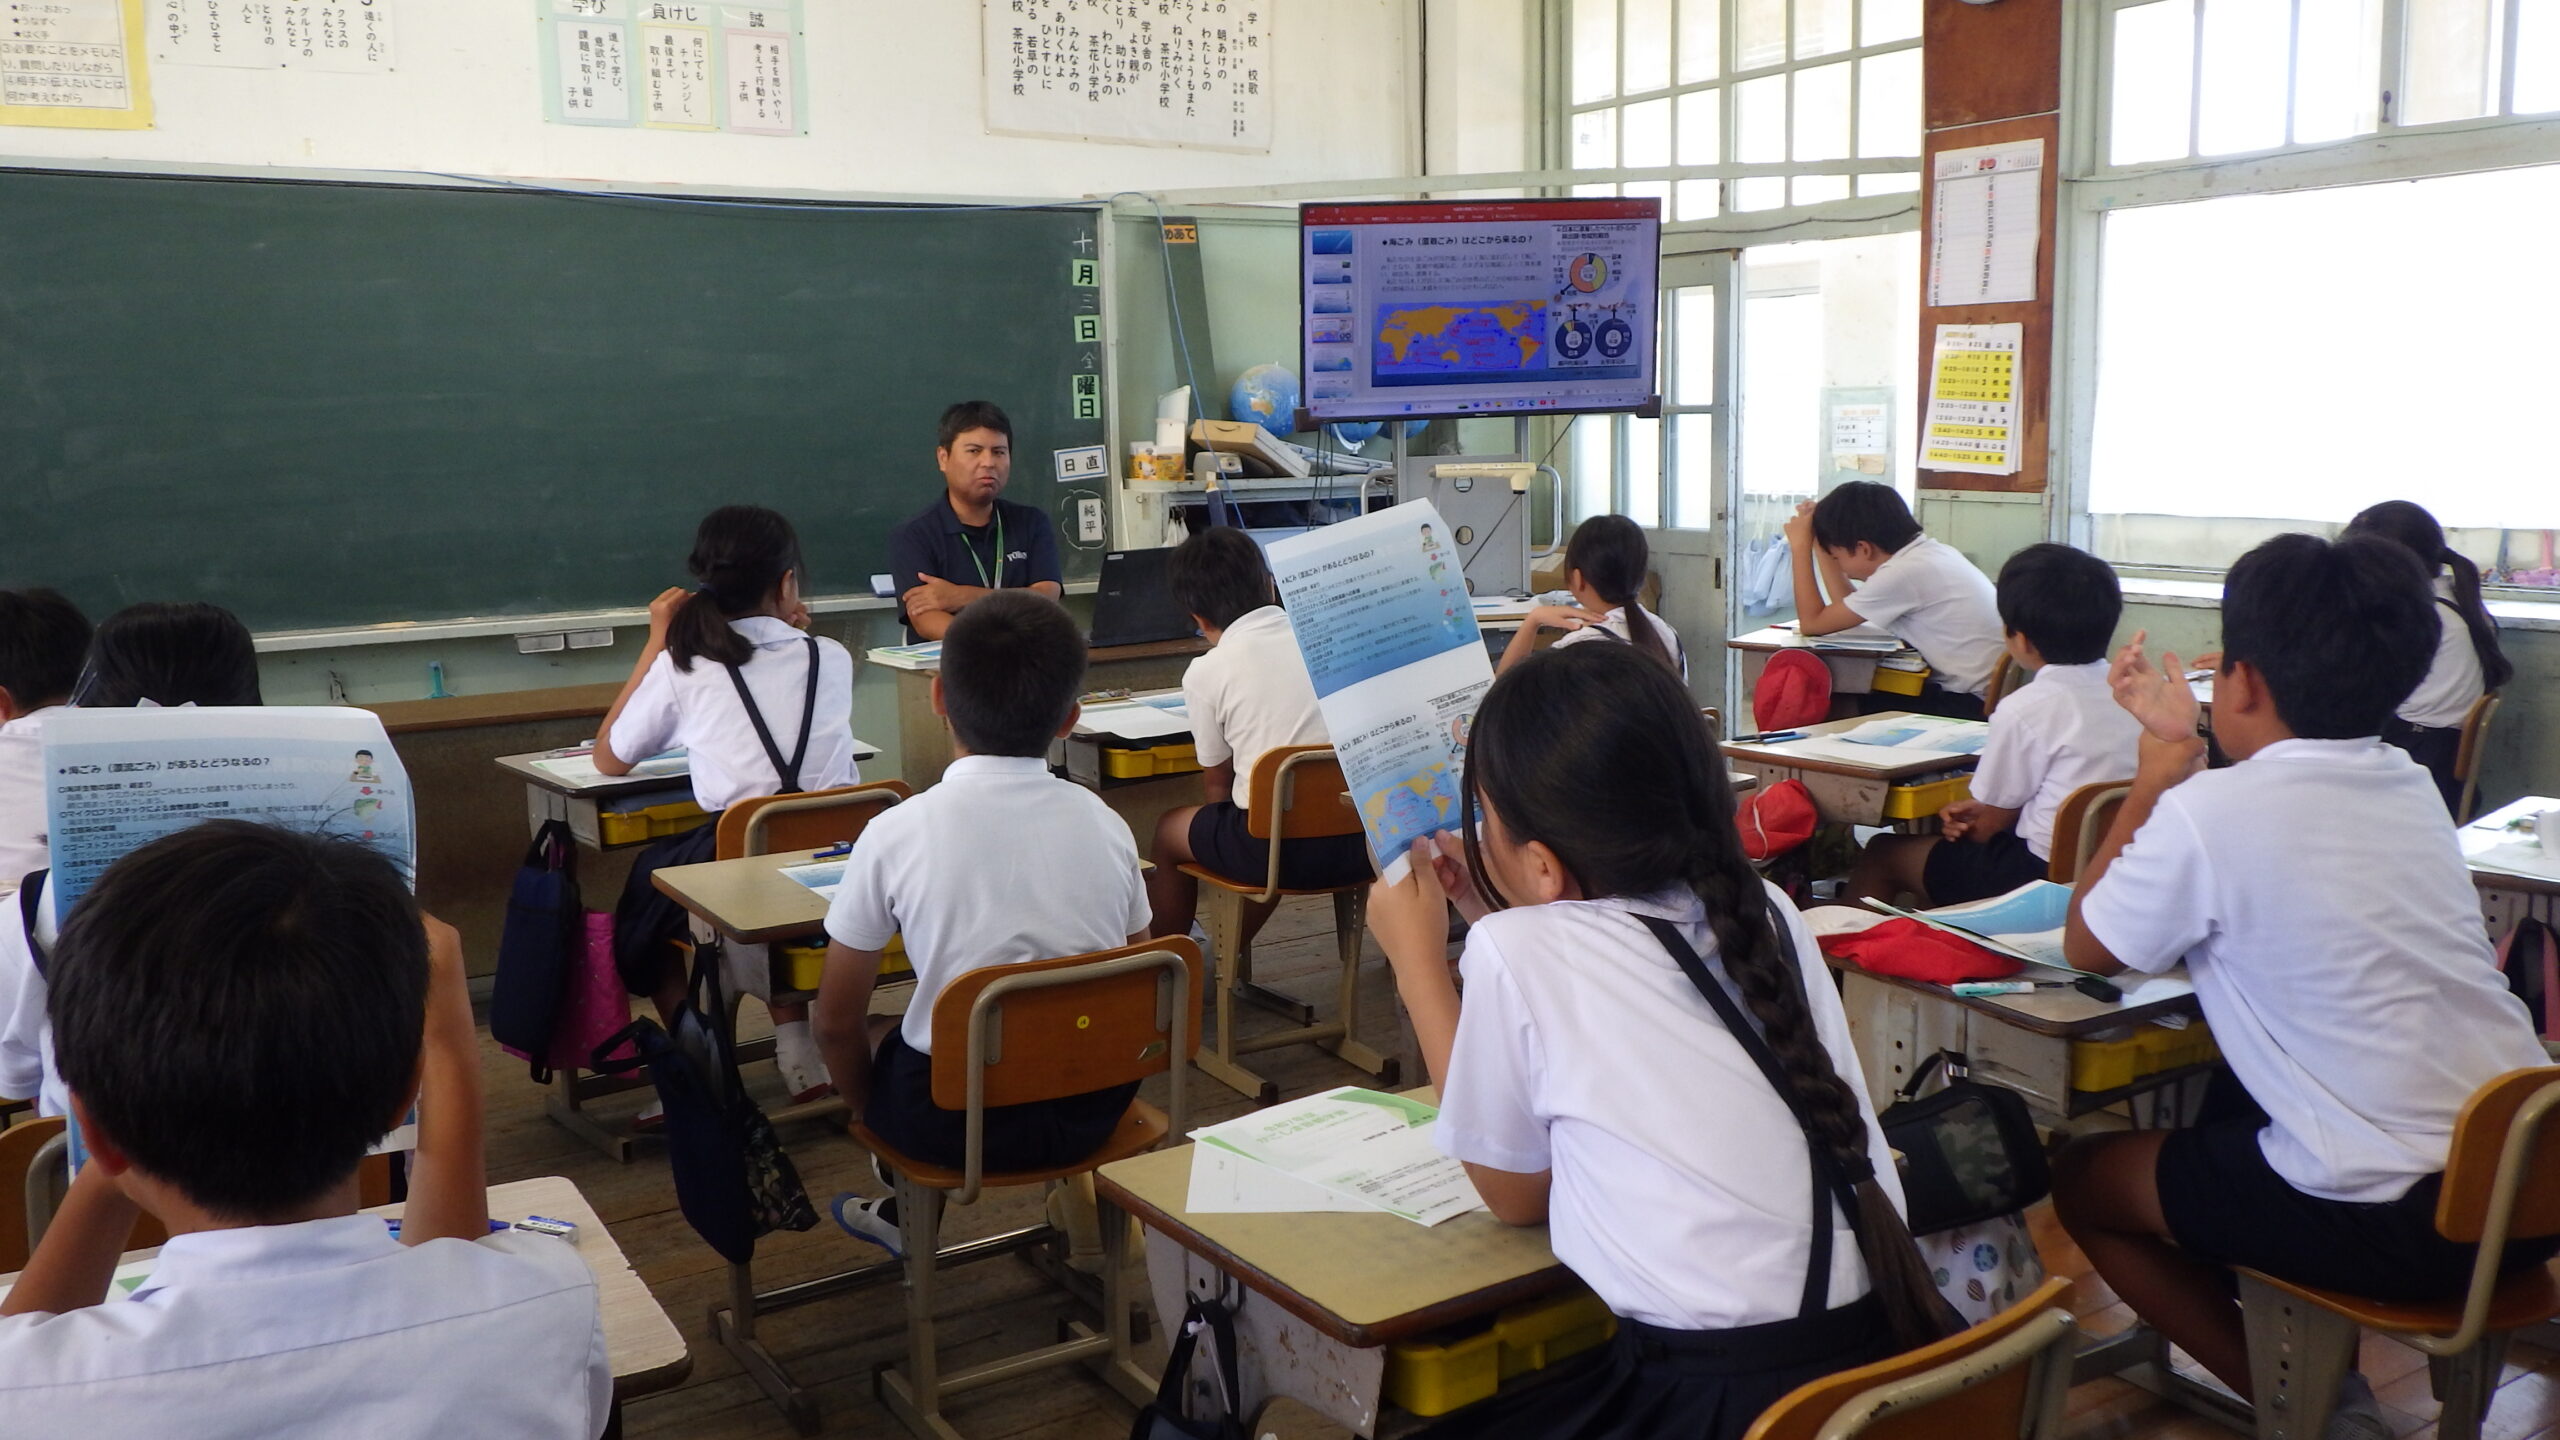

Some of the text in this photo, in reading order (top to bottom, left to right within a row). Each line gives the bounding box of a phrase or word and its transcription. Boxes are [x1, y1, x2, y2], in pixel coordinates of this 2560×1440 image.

[242, 3, 252, 24] 人と
[263, 4, 275, 46] となりの
[285, 6, 297, 48] みんなと
[300, 7, 313, 57] グループの
[322, 8, 335, 49] みんなに
[337, 8, 349, 48] クラスの
[652, 3, 697, 21] 負けじ
[578, 30, 593, 108] 課題に取り組む
[664, 35, 676, 78] 最後まで
[693, 37, 704, 81] 何にでも
[1012, 27, 1024, 96] 茶花小学校
[1027, 36, 1038, 75] 若草の
[1041, 24, 1052, 90] ひとすじに
[1055, 12, 1065, 78] あけくれよ
[1069, 26, 1080, 92] みんなみの
[1088, 35, 1099, 102] 茶花小学校
[1102, 30, 1113, 95] わたしらの
[1115, 44, 1126, 95] 助けあい
[1129, 33, 1140, 84] よき親が
[1141, 21, 1152, 72] 学び舎の
[1173, 25, 1183, 89] ねりみがく
[1202, 28, 1213, 91] わたしらの
[1217, 29, 1227, 80] 朝あけの
[568, 86, 579, 109] 子供
[649, 45, 664, 112] 取り組む子供
[739, 81, 749, 103] 子供
[754, 43, 766, 118] 考えて行動する
[1159, 43, 1170, 108] 茶花小学校
[1186, 40, 1195, 117] きょうもまた
[1078, 264, 1093, 284] 月
[1081, 320, 1096, 339] 日
[1077, 376, 1096, 417] 曜日
